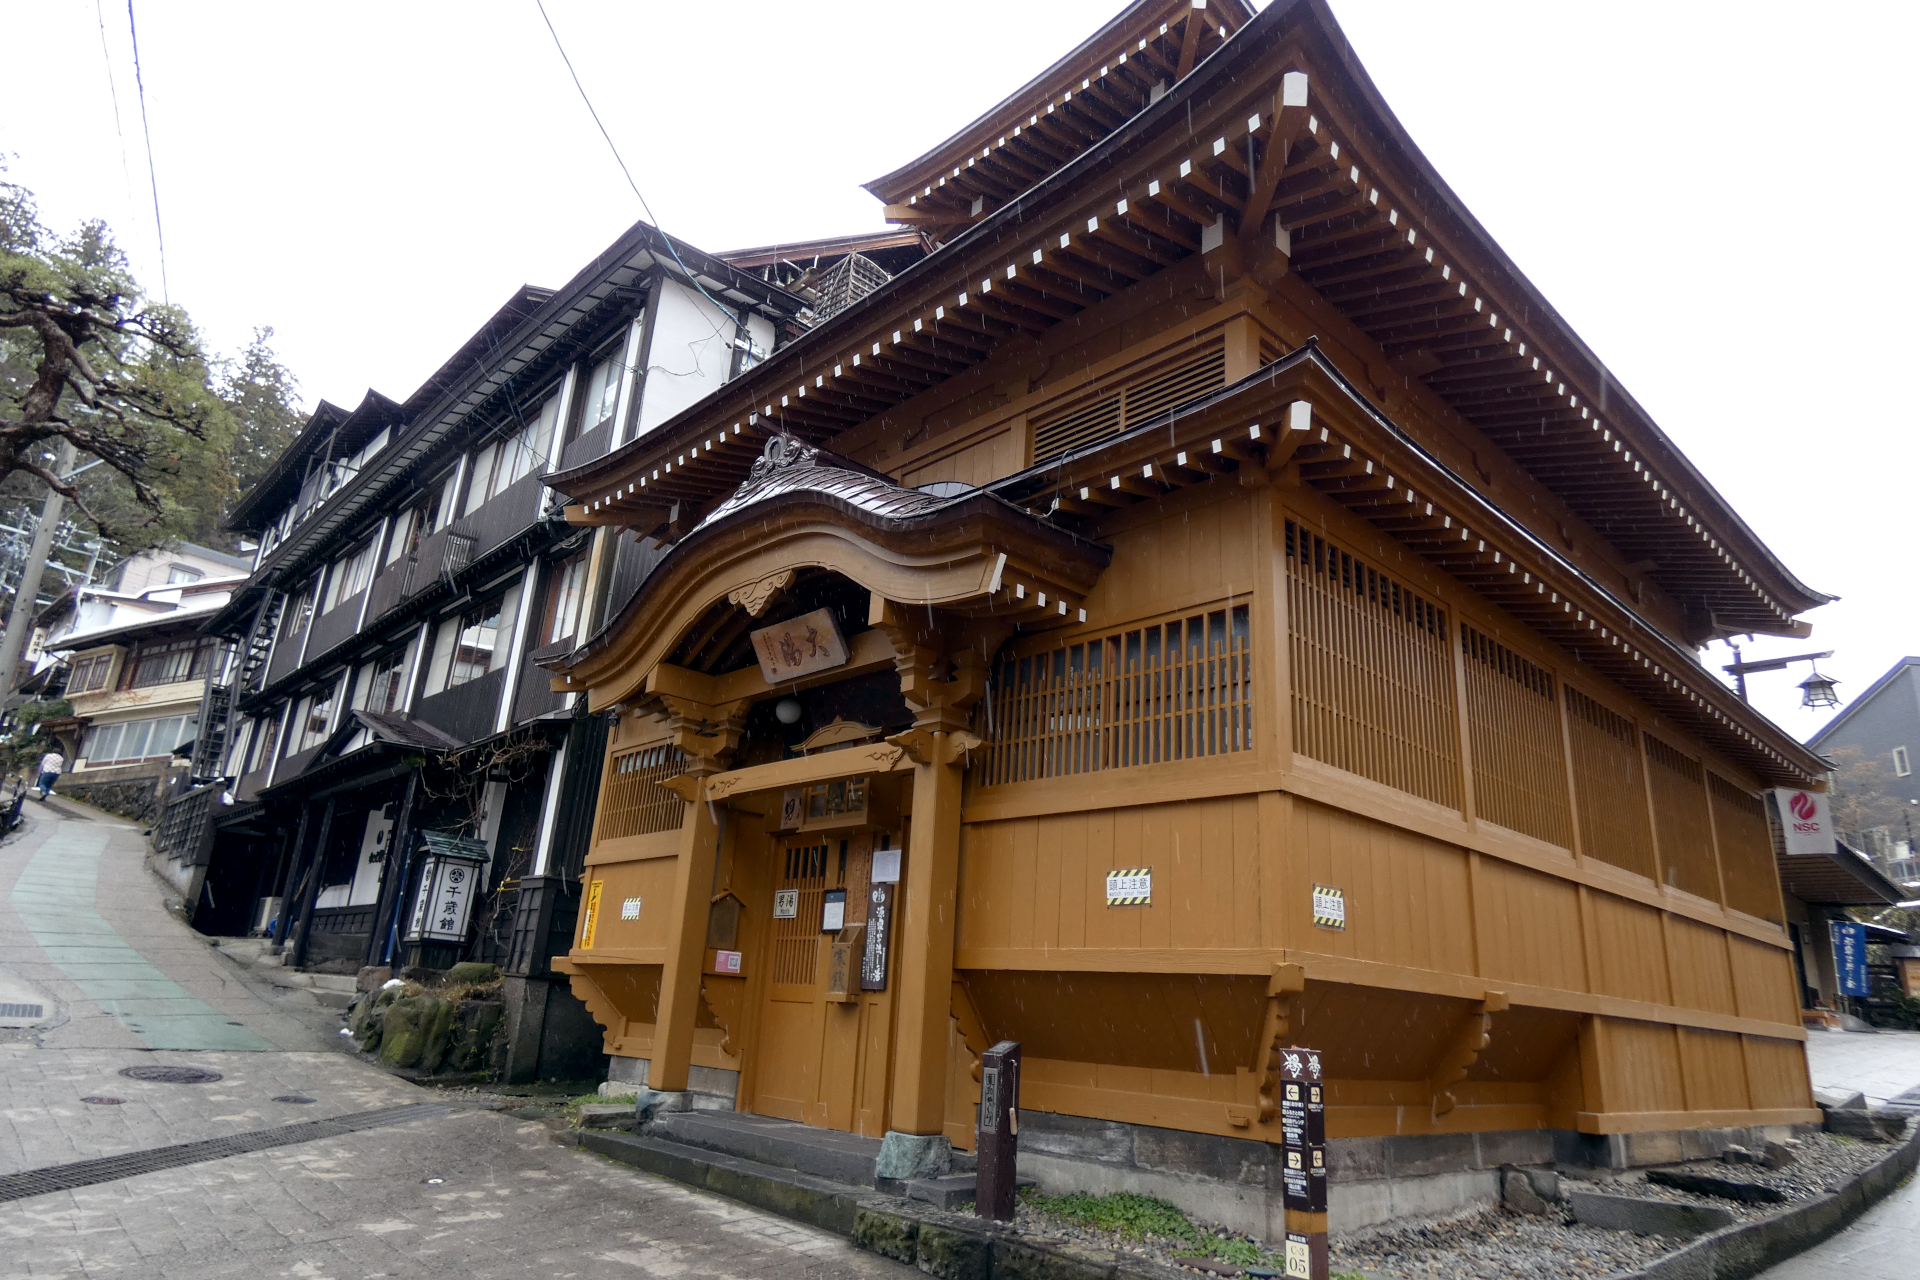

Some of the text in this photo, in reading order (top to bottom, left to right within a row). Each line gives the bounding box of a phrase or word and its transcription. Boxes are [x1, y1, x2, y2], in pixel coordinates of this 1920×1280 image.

[1793, 822, 1820, 832] NSC
[1109, 877, 1149, 891] 頭上注意
[439, 886, 462, 931] 千歳館
[1290, 1245, 1305, 1256] C-3
[1290, 1256, 1306, 1273] 05
